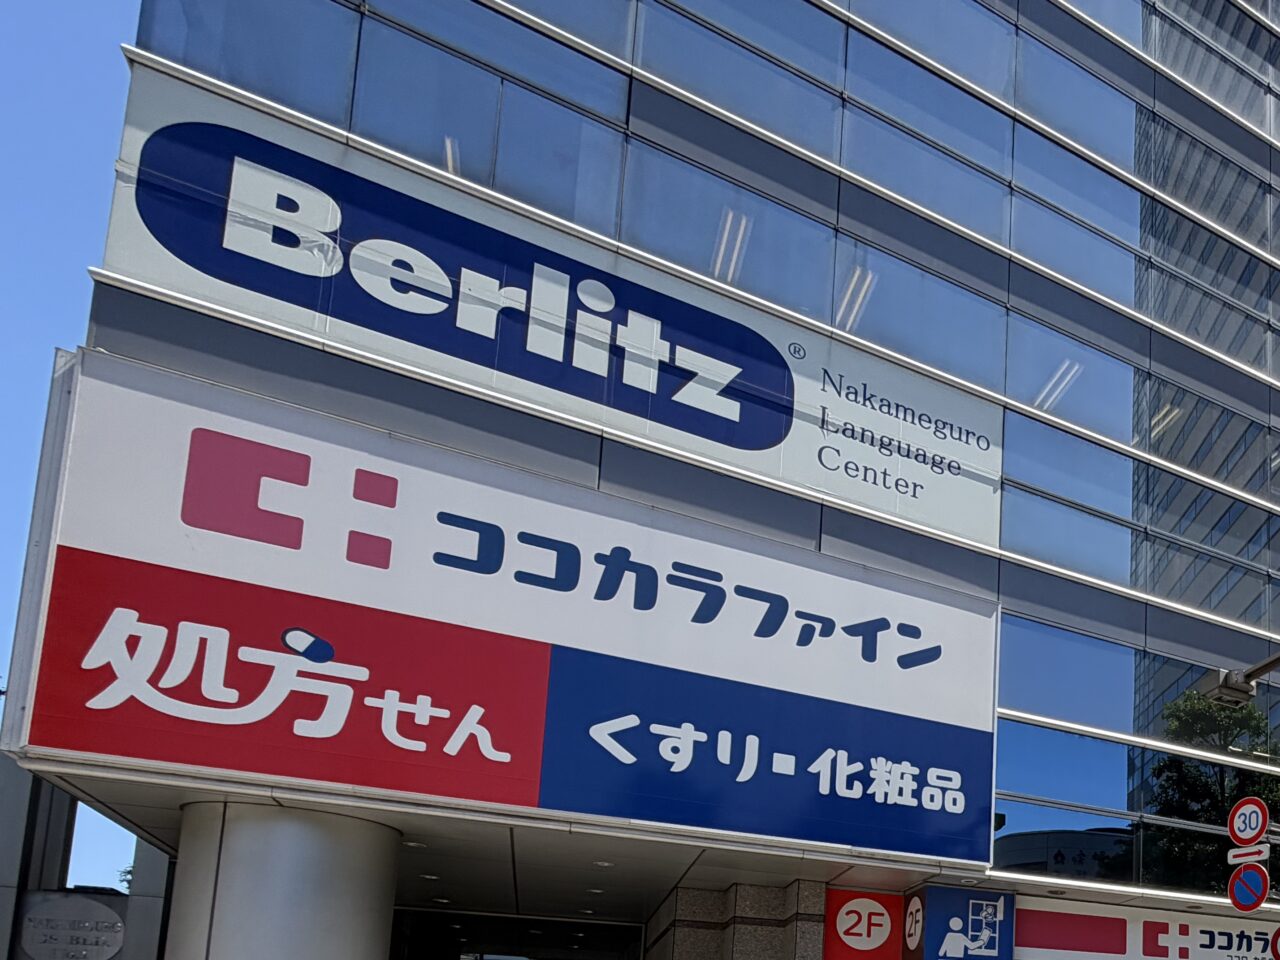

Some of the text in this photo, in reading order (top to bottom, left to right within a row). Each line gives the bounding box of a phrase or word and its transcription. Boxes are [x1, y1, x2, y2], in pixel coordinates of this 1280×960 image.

[223, 155, 743, 423] Berlitz
[818, 405, 961, 475] Language
[820, 367, 991, 451] Nakameguro
[817, 445, 925, 499] Center
[432, 511, 942, 670] ココカラファイン
[80, 607, 511, 762] 処方せん
[1237, 810, 1260, 833] 30
[843, 909, 885, 938] 2F
[906, 909, 921, 939] 2F
